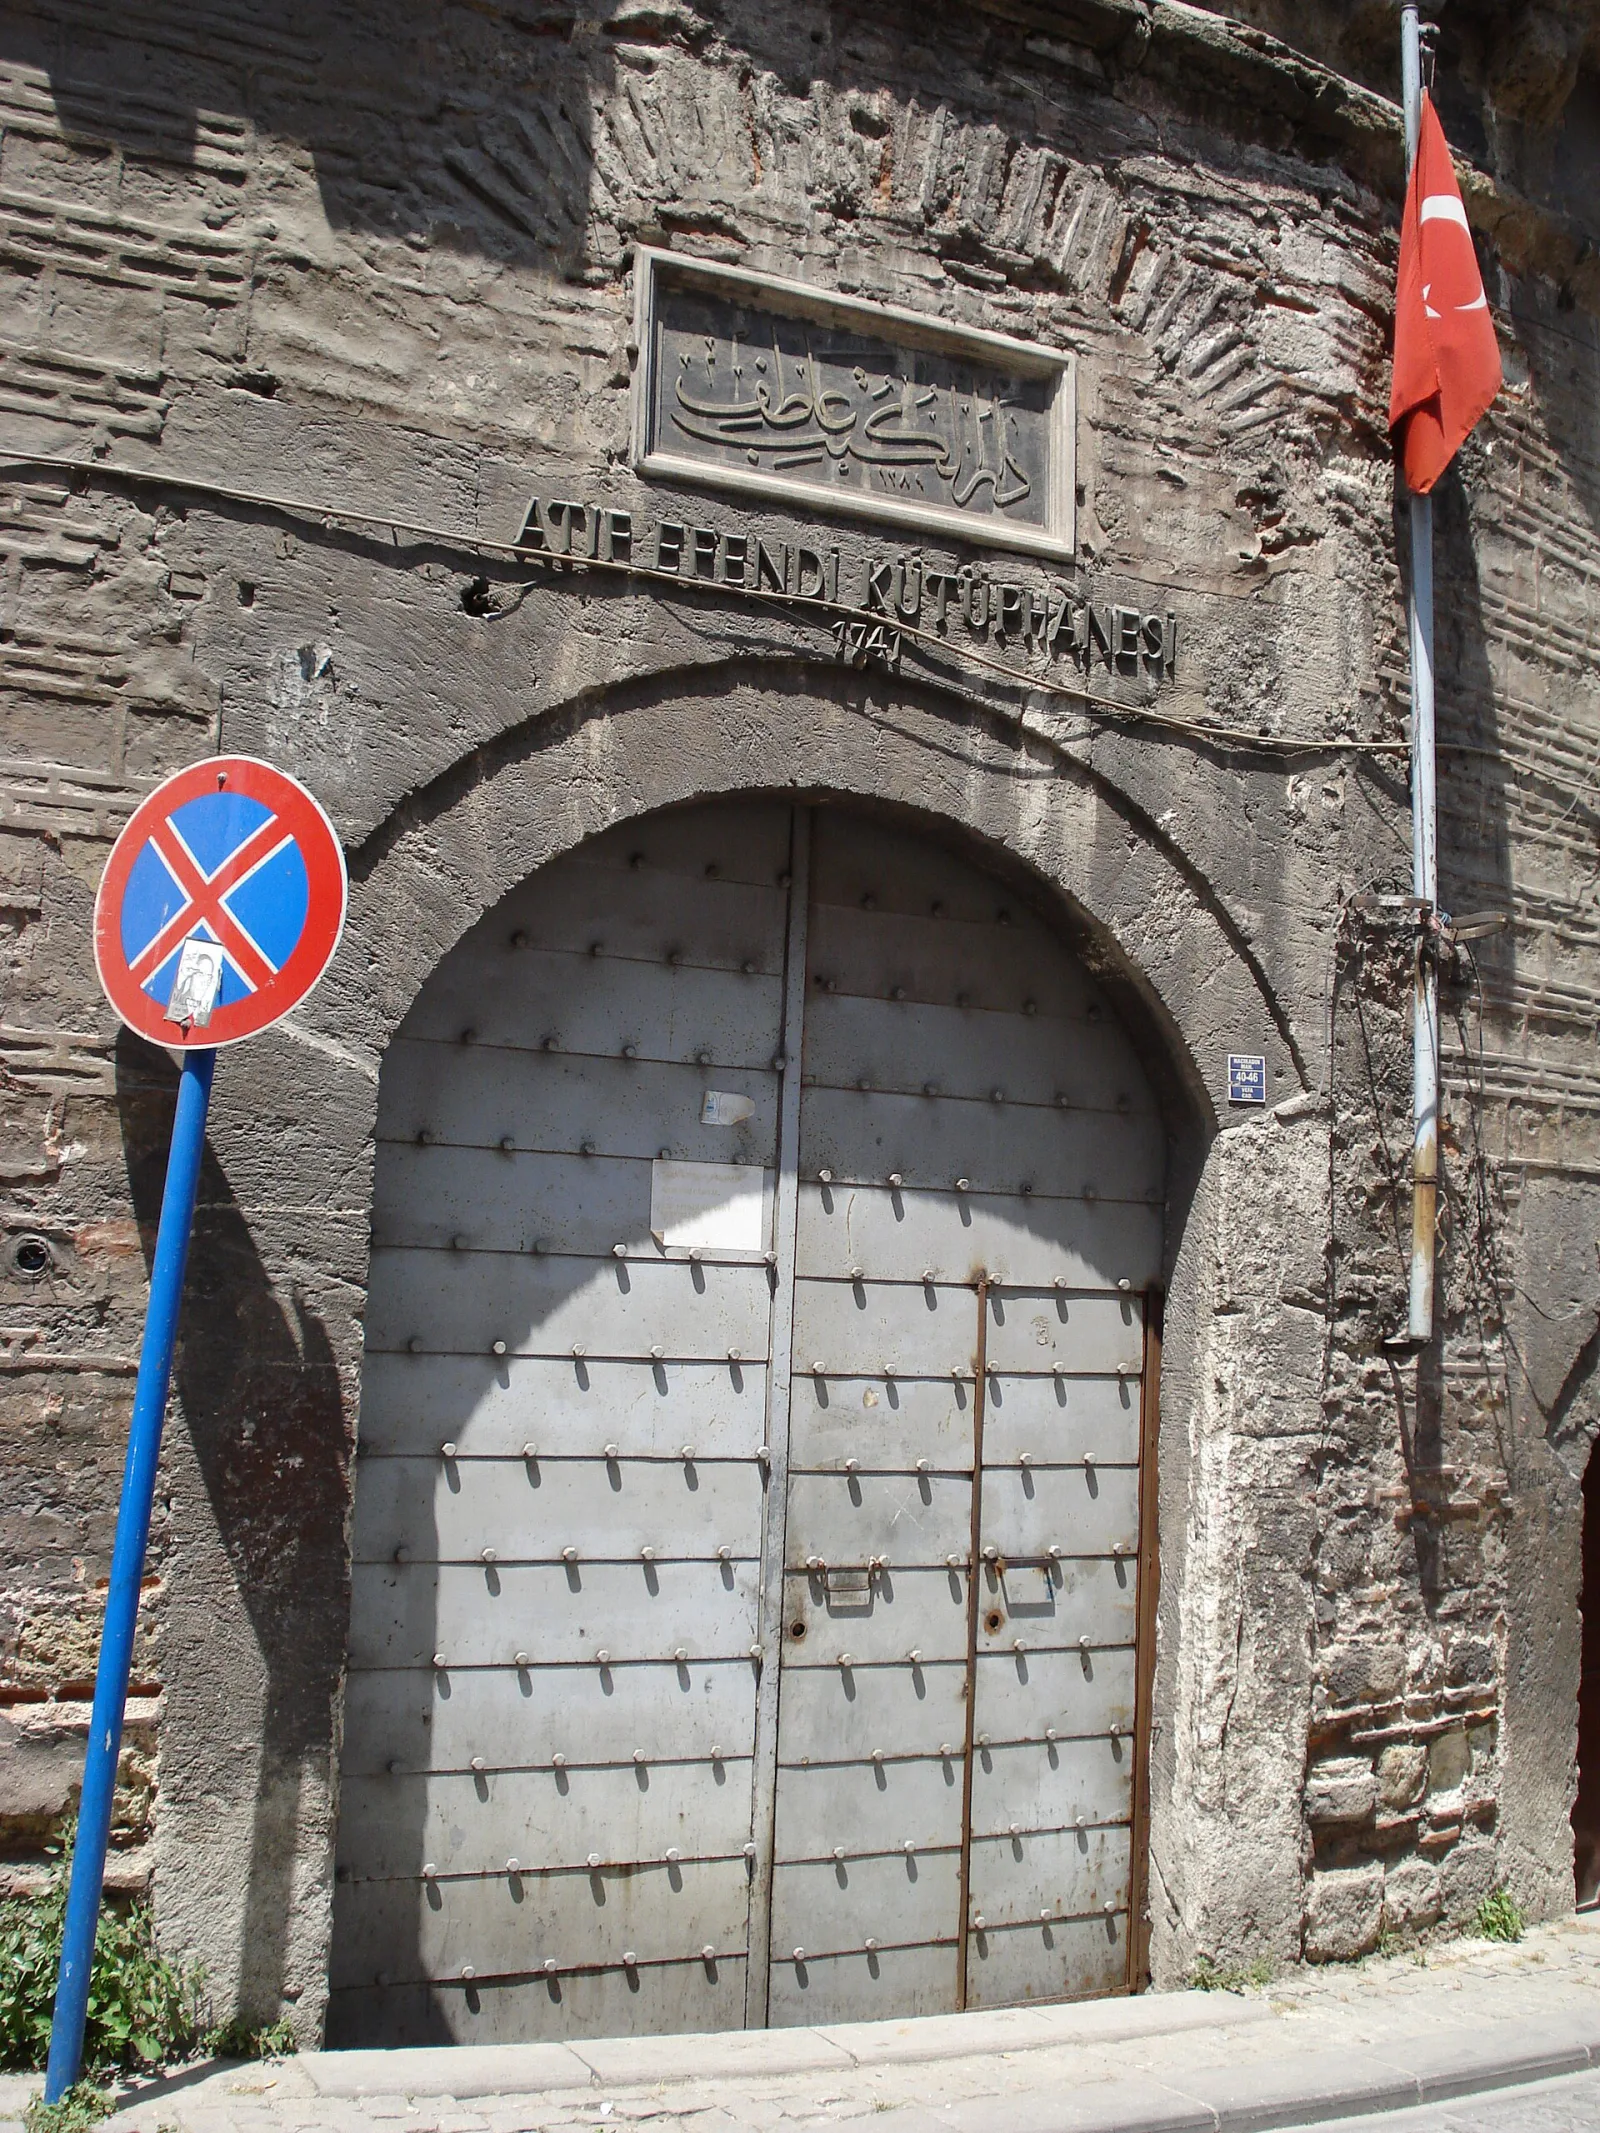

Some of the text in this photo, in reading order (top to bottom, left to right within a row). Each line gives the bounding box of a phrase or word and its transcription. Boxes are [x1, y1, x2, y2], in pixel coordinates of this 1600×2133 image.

[511, 497, 631, 562] ATIF
[831, 620, 901, 664] 1741
[1235, 1071, 1259, 1083] 40-46
